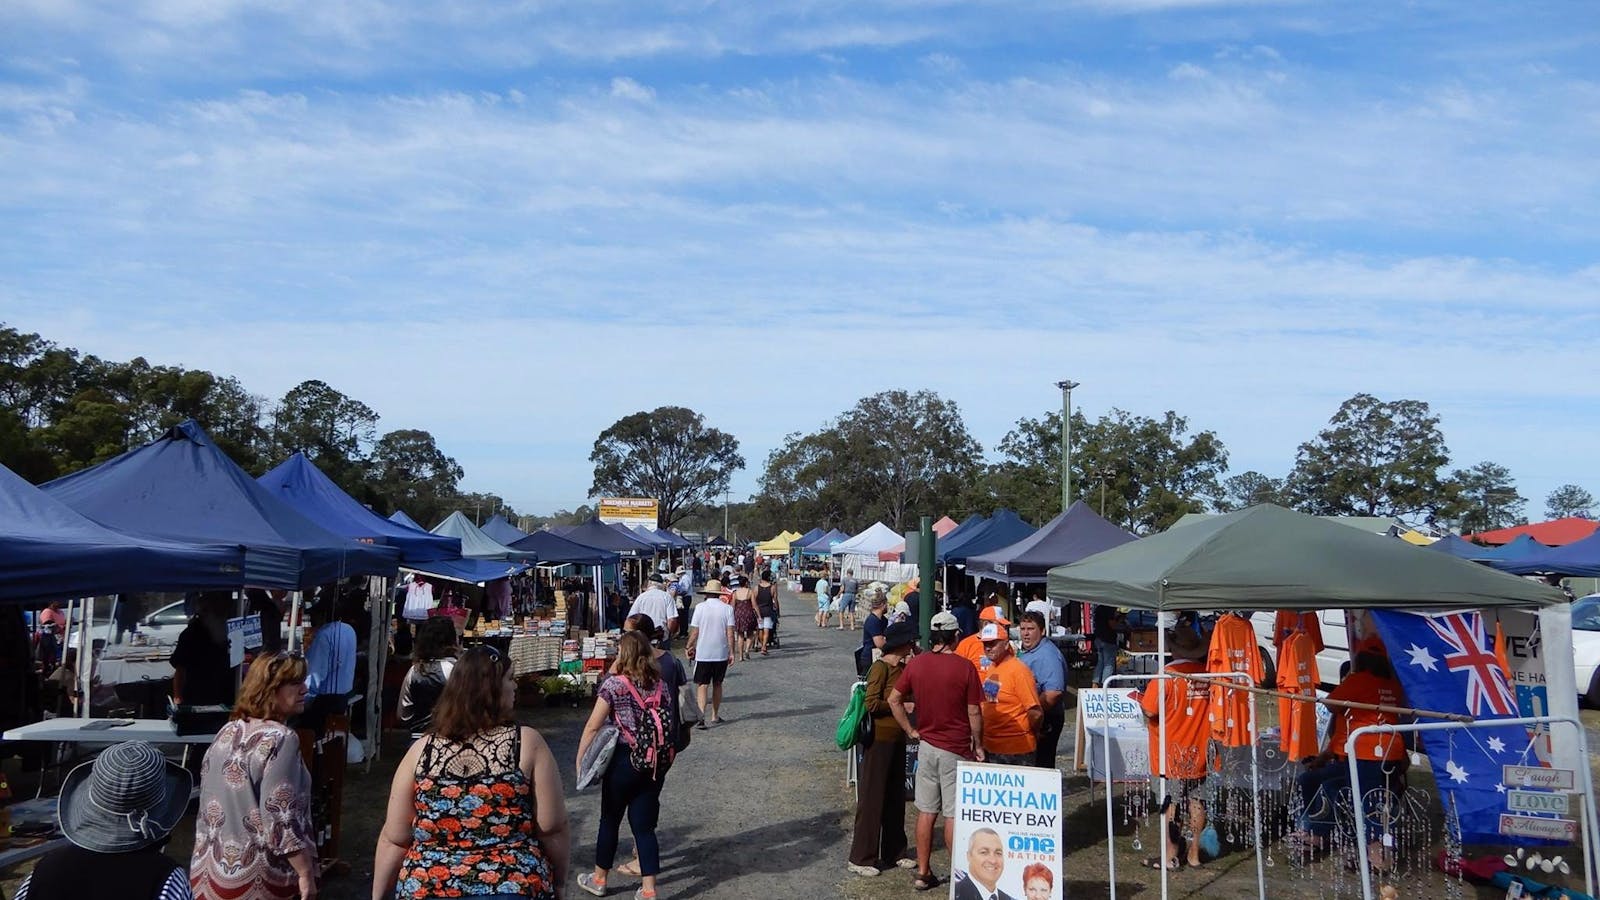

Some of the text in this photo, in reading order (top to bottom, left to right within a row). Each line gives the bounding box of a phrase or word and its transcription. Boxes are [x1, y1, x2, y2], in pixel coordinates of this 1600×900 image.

[1085, 693, 1120, 702] JAMES
[1086, 702, 1136, 713] HANSEN
[962, 771, 1025, 788] DAMIAN
[962, 787, 1057, 811] HUXHAM
[961, 808, 1056, 828] HERVEY BAY
[1008, 835, 1055, 854] one
[1007, 851, 1055, 862] NATION
